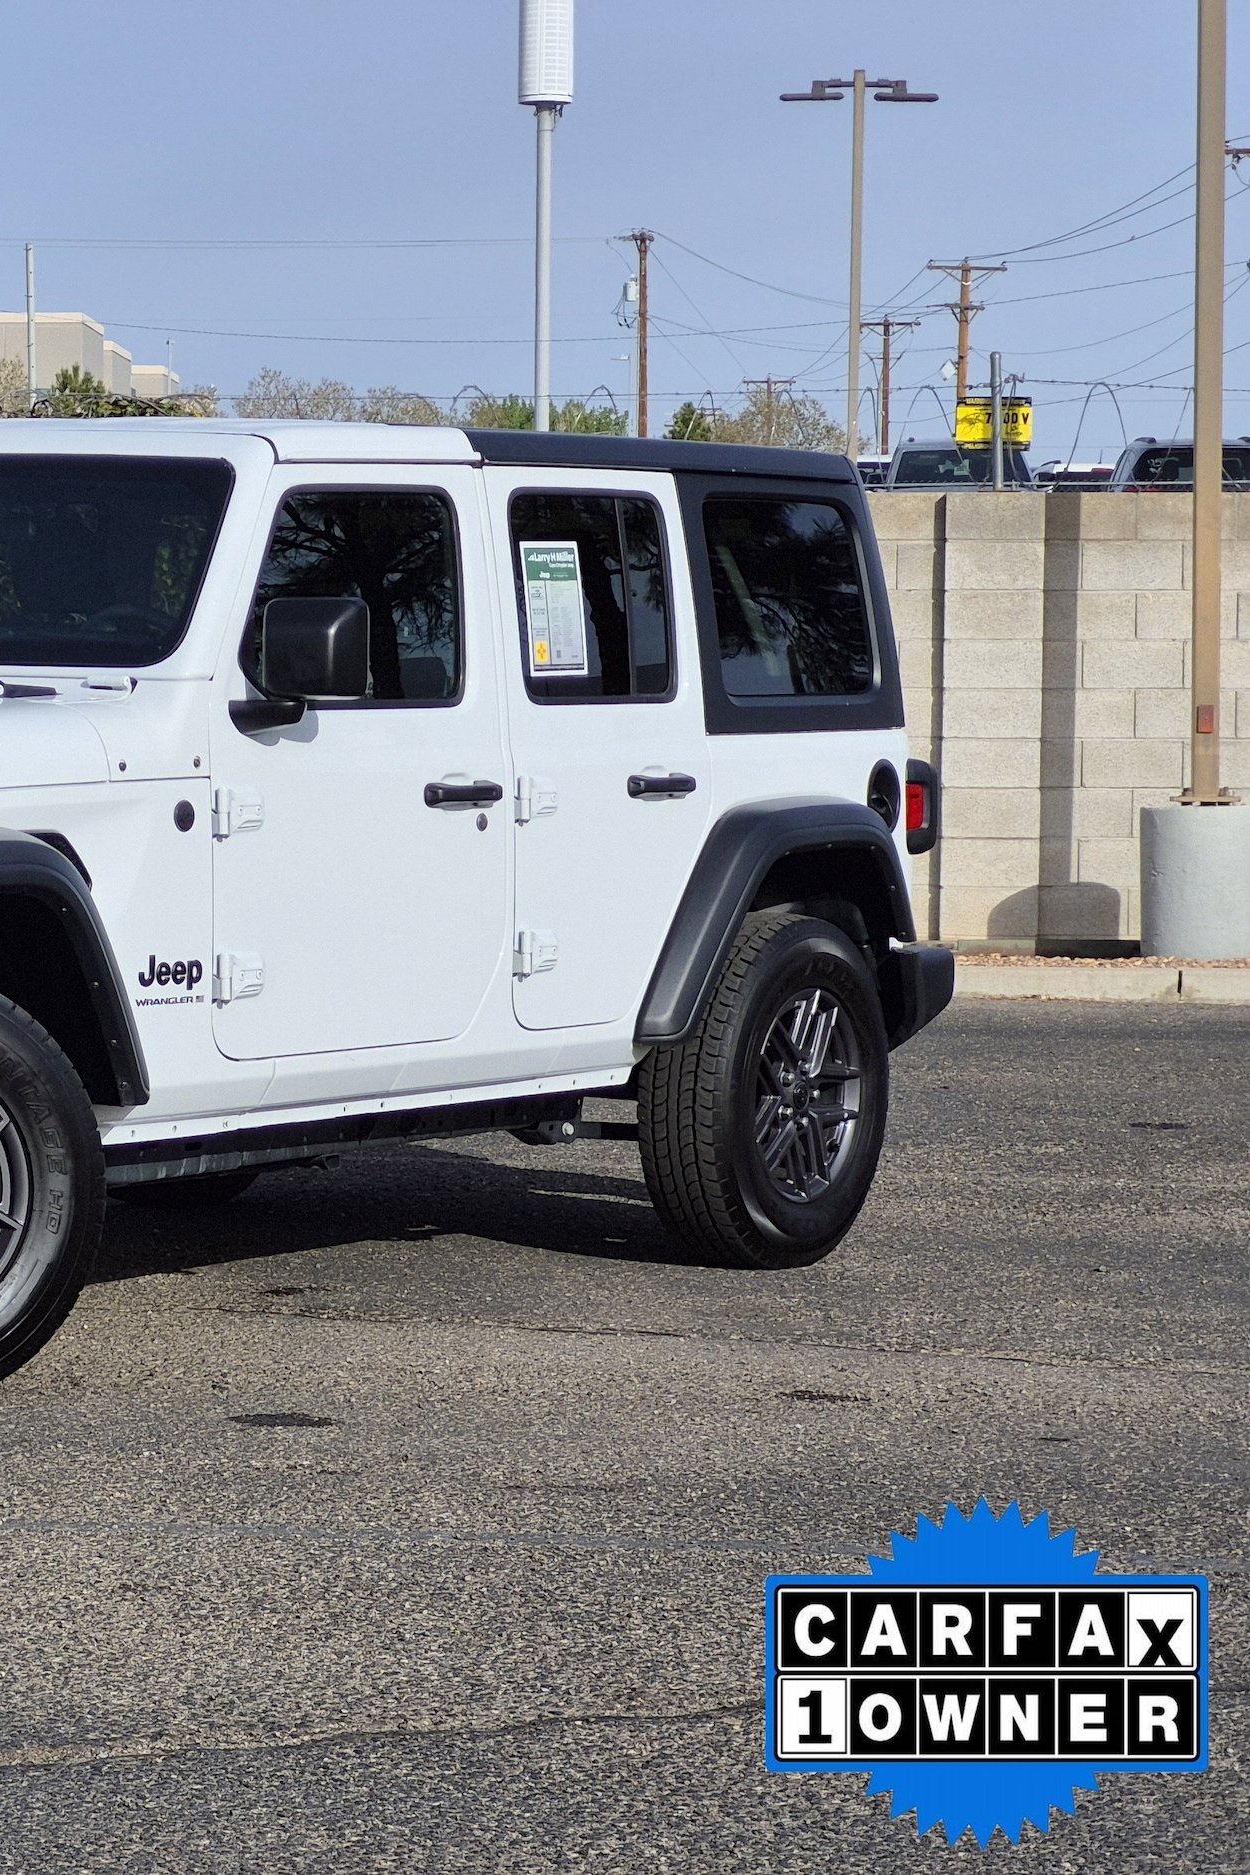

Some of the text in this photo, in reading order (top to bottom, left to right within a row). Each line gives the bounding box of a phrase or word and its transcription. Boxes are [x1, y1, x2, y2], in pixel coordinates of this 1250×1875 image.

[985, 412, 1030, 424] 700 V
[138, 954, 203, 991] Jeep
[135, 995, 194, 1007] WRANGLER
[46, 1189, 64, 1234] HD
